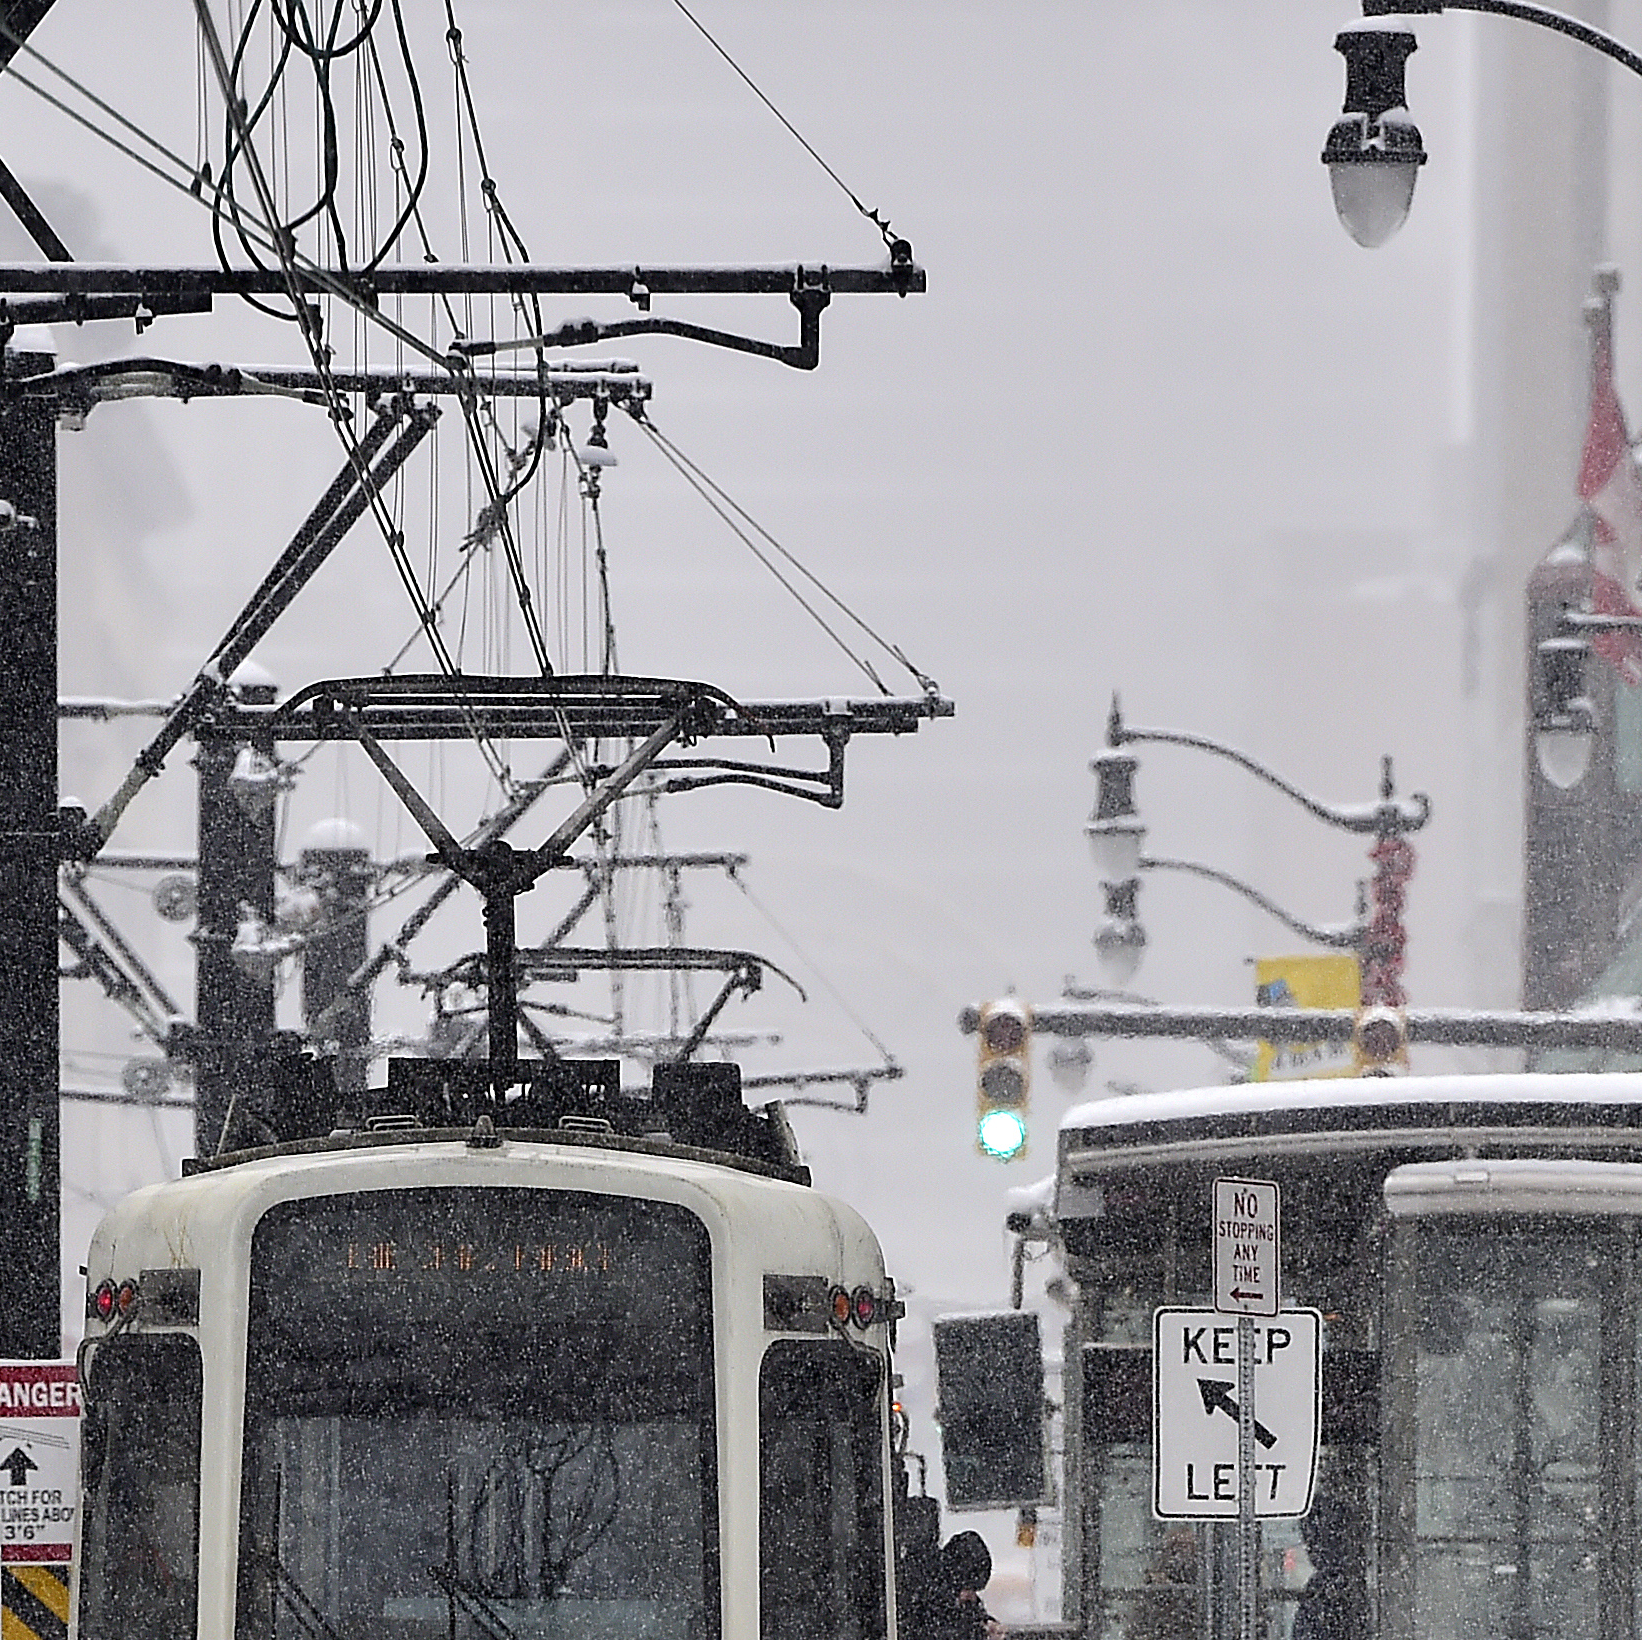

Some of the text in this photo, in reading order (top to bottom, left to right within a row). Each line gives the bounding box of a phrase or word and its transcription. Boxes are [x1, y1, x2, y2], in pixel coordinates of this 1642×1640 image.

[1233, 1192, 1258, 1219] NO
[1218, 1220, 1275, 1242] STOPPING
[1233, 1244, 1259, 1263] ANY
[1232, 1265, 1261, 1284] TIME
[1183, 1327, 1292, 1365] KEP
[1186, 1463, 1287, 1501] LET
[31, 1489, 62, 1505] FOR
[1, 1508, 39, 1522] LINES
